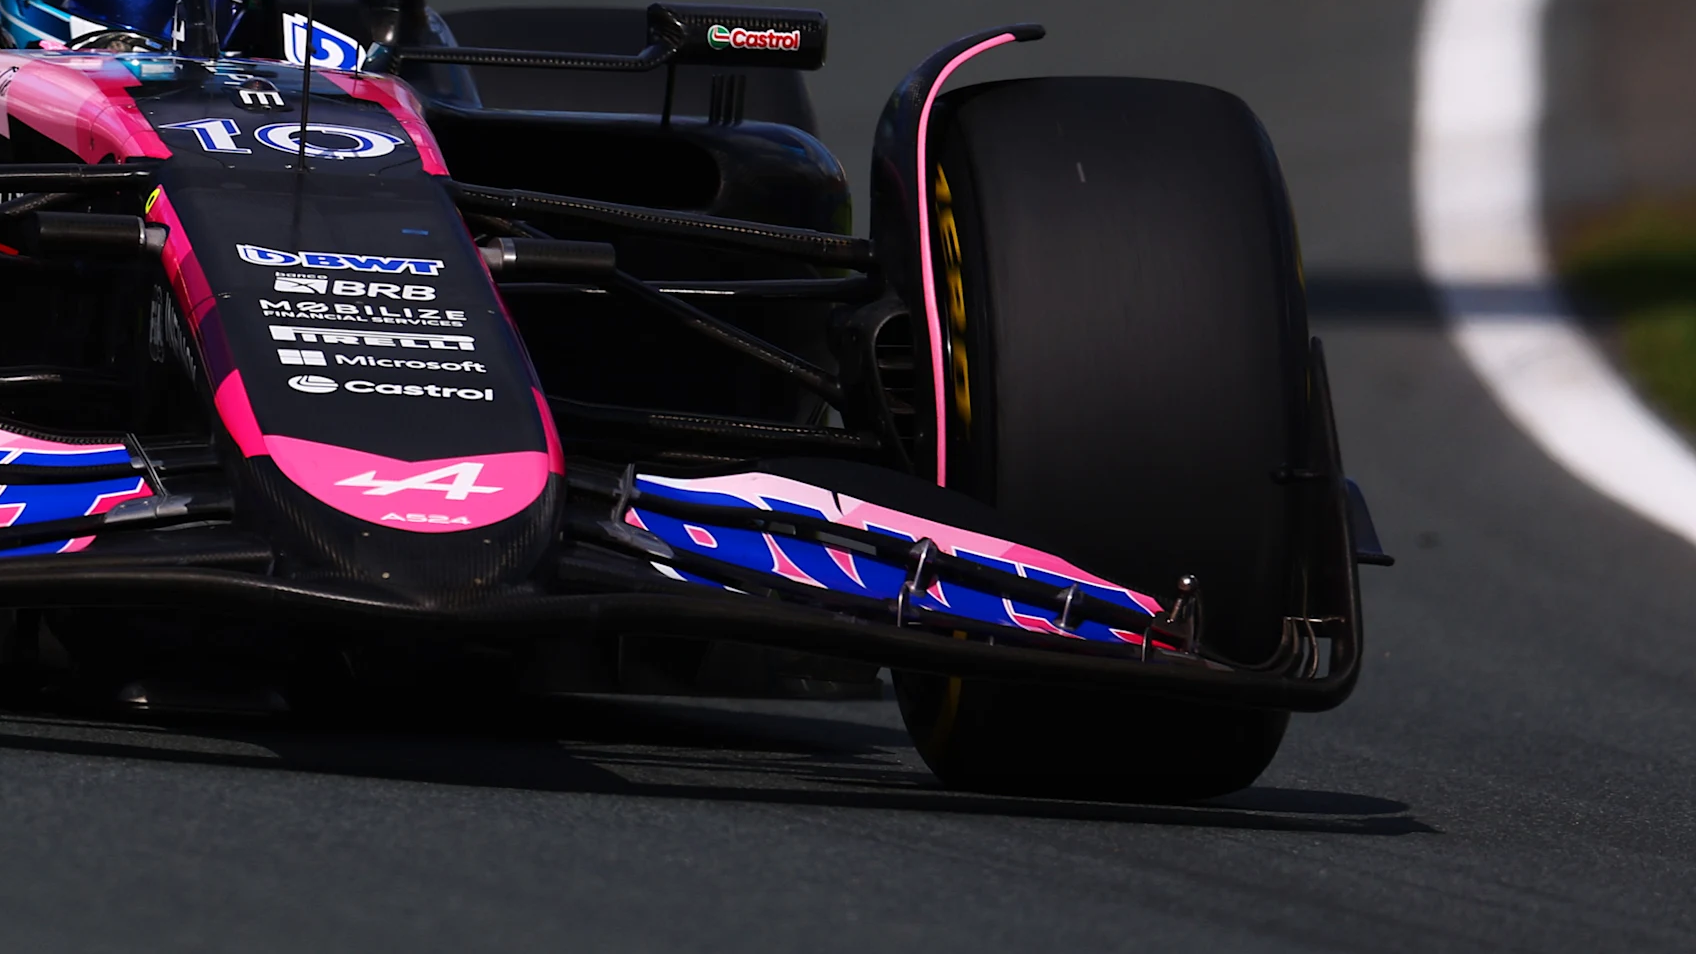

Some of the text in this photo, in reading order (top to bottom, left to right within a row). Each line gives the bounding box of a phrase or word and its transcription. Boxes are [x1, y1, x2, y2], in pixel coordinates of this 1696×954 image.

[729, 27, 801, 51] Castrol
[159, 118, 405, 160] 10
[298, 251, 445, 276] BWT
[275, 271, 329, 280] banco
[332, 280, 437, 301] BRB
[263, 310, 464, 327] FINANCIAL SERVICES
[269, 325, 475, 351] PIRELLI
[334, 354, 487, 373] Microsoft
[344, 380, 493, 401] Castrol
[381, 512, 472, 525] A524
